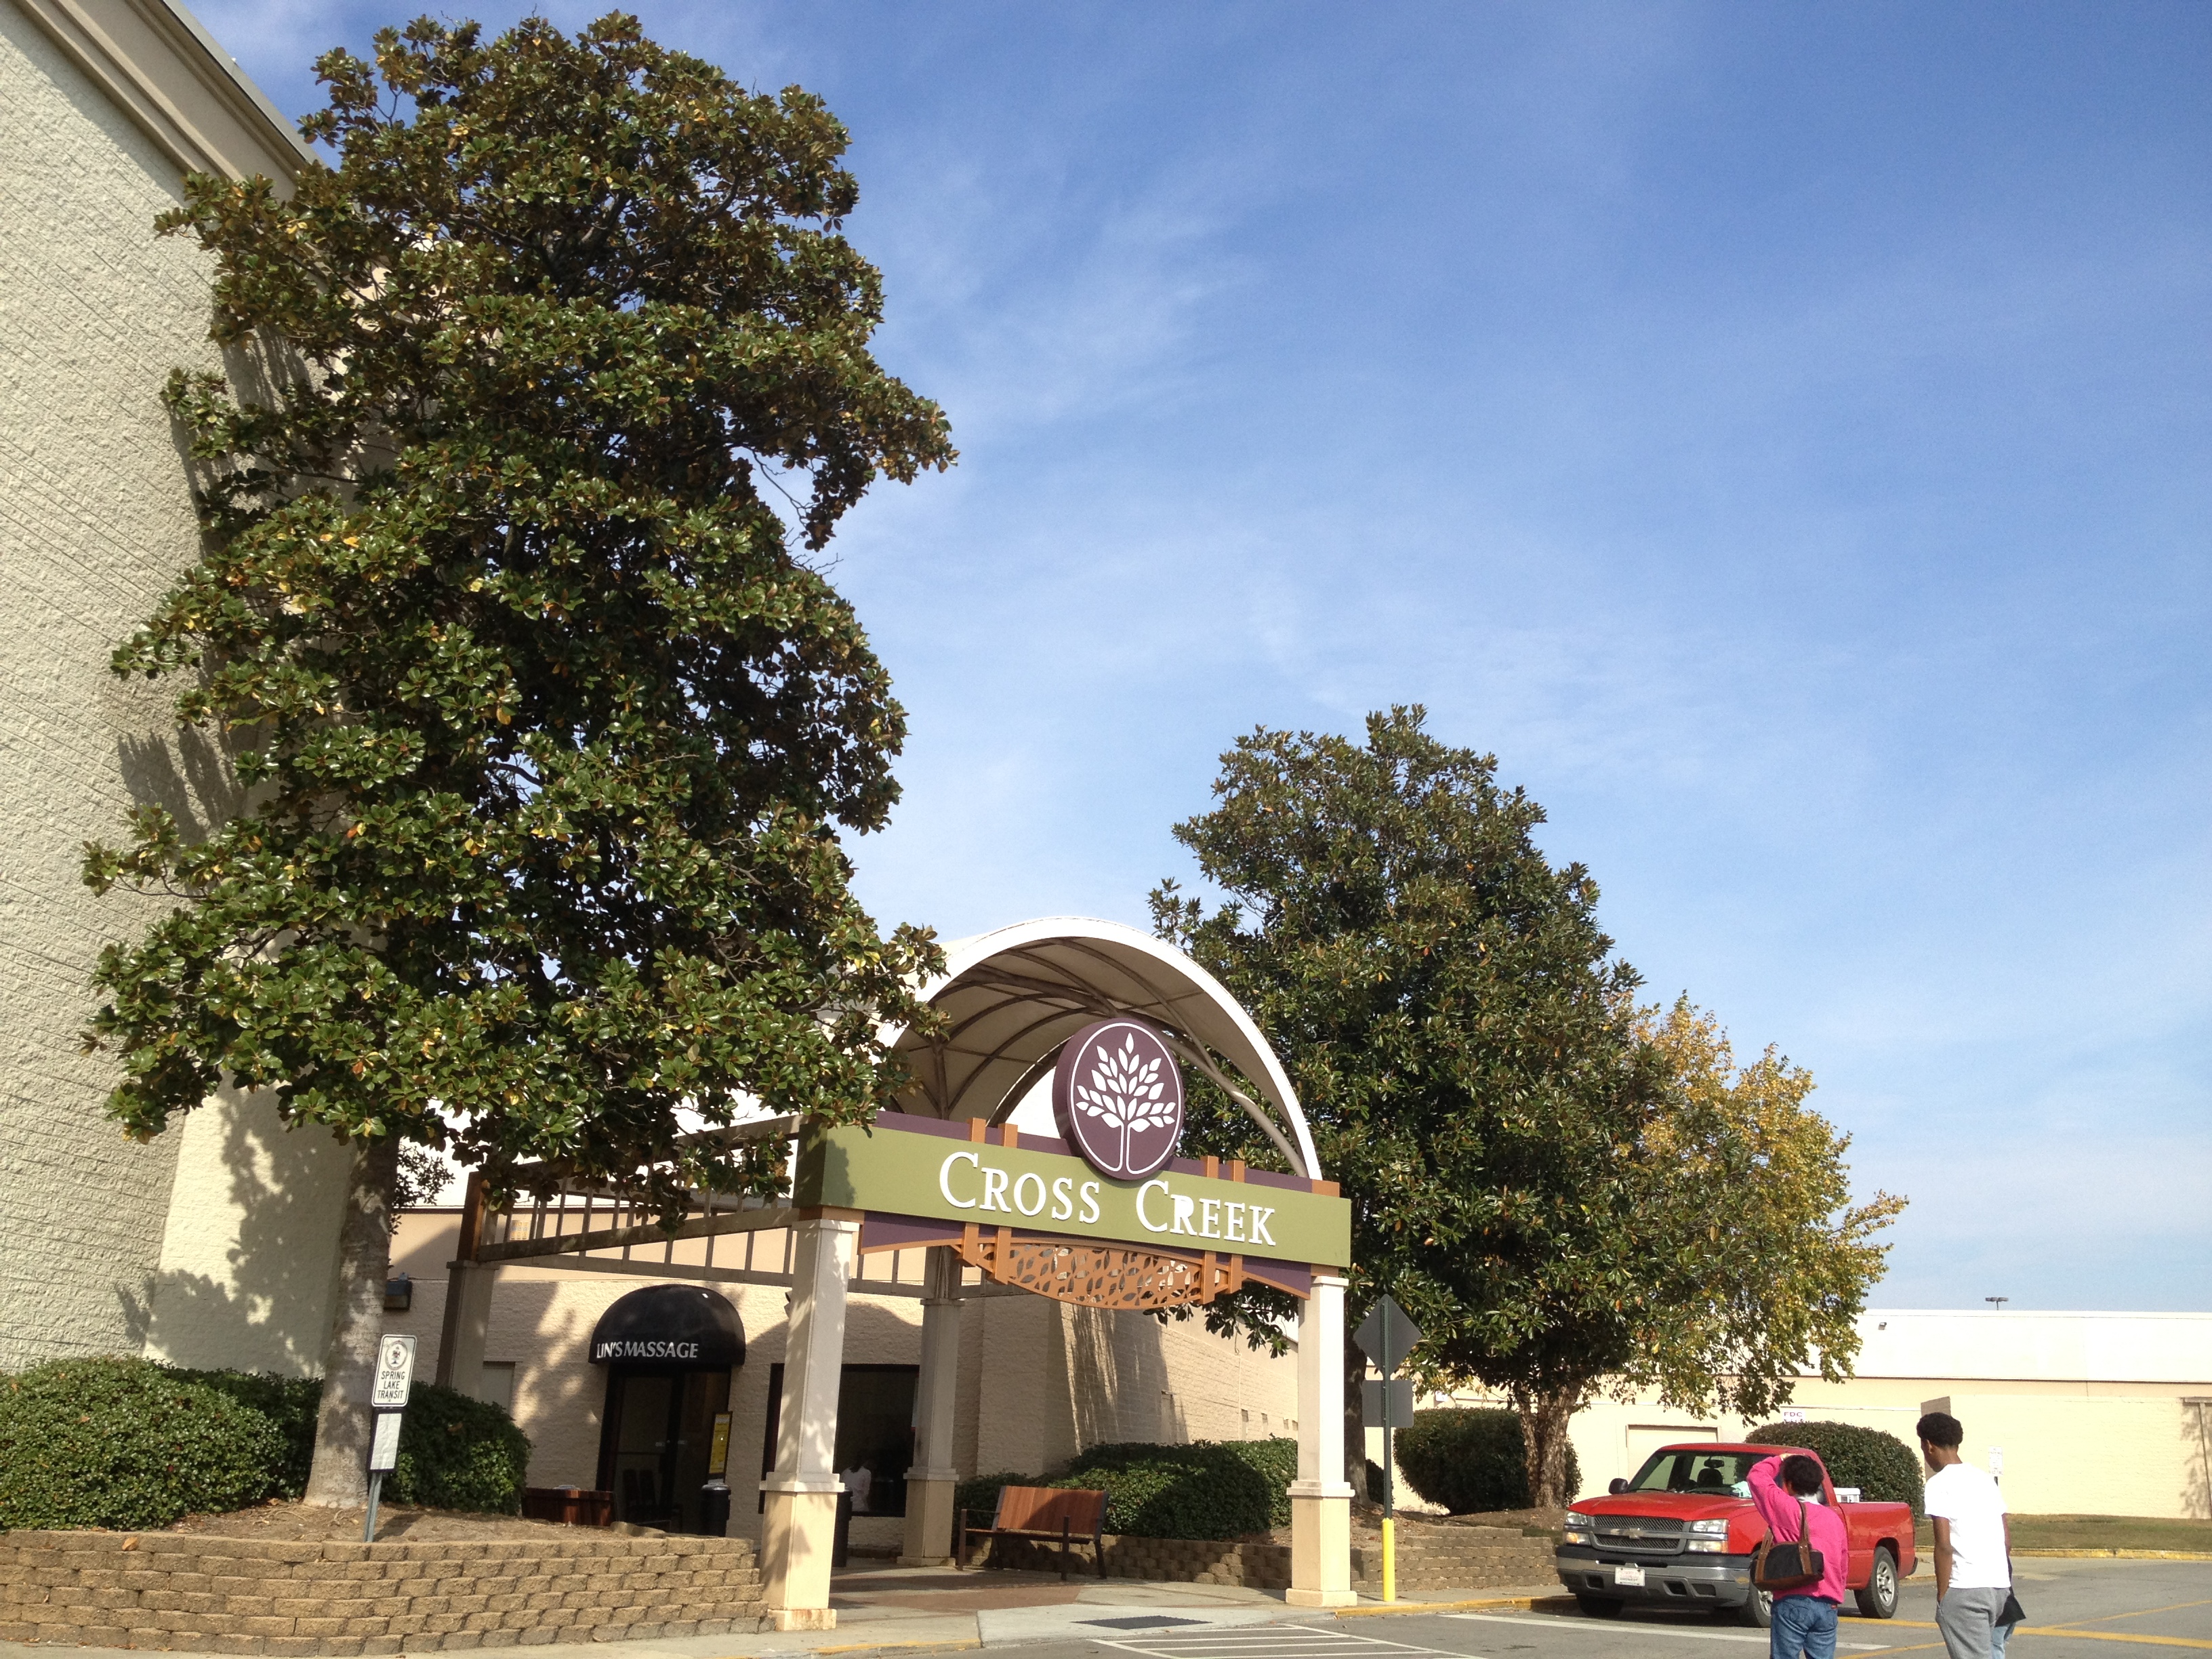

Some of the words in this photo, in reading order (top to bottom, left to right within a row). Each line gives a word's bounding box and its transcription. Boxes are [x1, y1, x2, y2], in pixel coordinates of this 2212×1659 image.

[939, 1151, 1101, 1225] CROSS
[1136, 1180, 1276, 1246] CREEK
[623, 1341, 699, 1358] MASSAGE
[381, 1370, 405, 1380] SPRING
[384, 1380, 400, 1389] LAKE
[377, 1390, 404, 1399] TRANSIT
